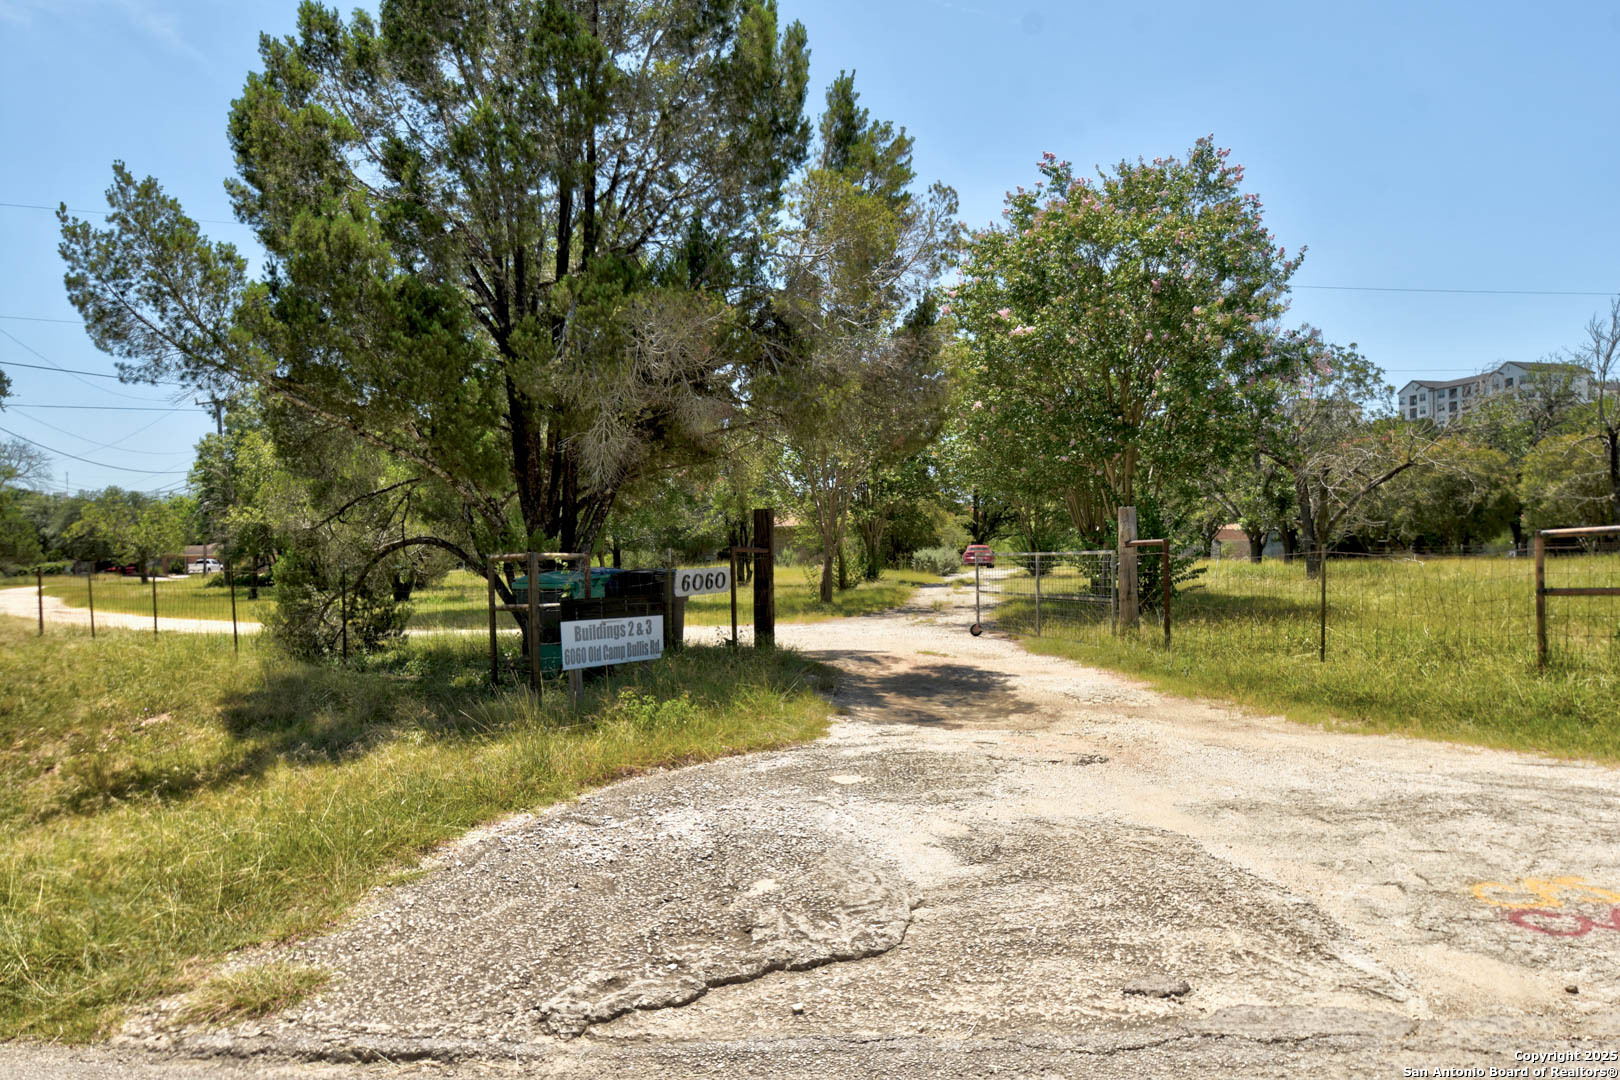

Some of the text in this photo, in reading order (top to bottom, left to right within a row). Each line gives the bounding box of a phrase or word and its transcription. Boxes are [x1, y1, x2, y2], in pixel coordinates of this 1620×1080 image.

[681, 571, 727, 593] 6060
[574, 619, 653, 642] Buildings 2 & 3
[564, 647, 587, 666] 6060
[588, 645, 602, 662] Old
[603, 644, 626, 661] Camp
[627, 640, 649, 657] Bullis
